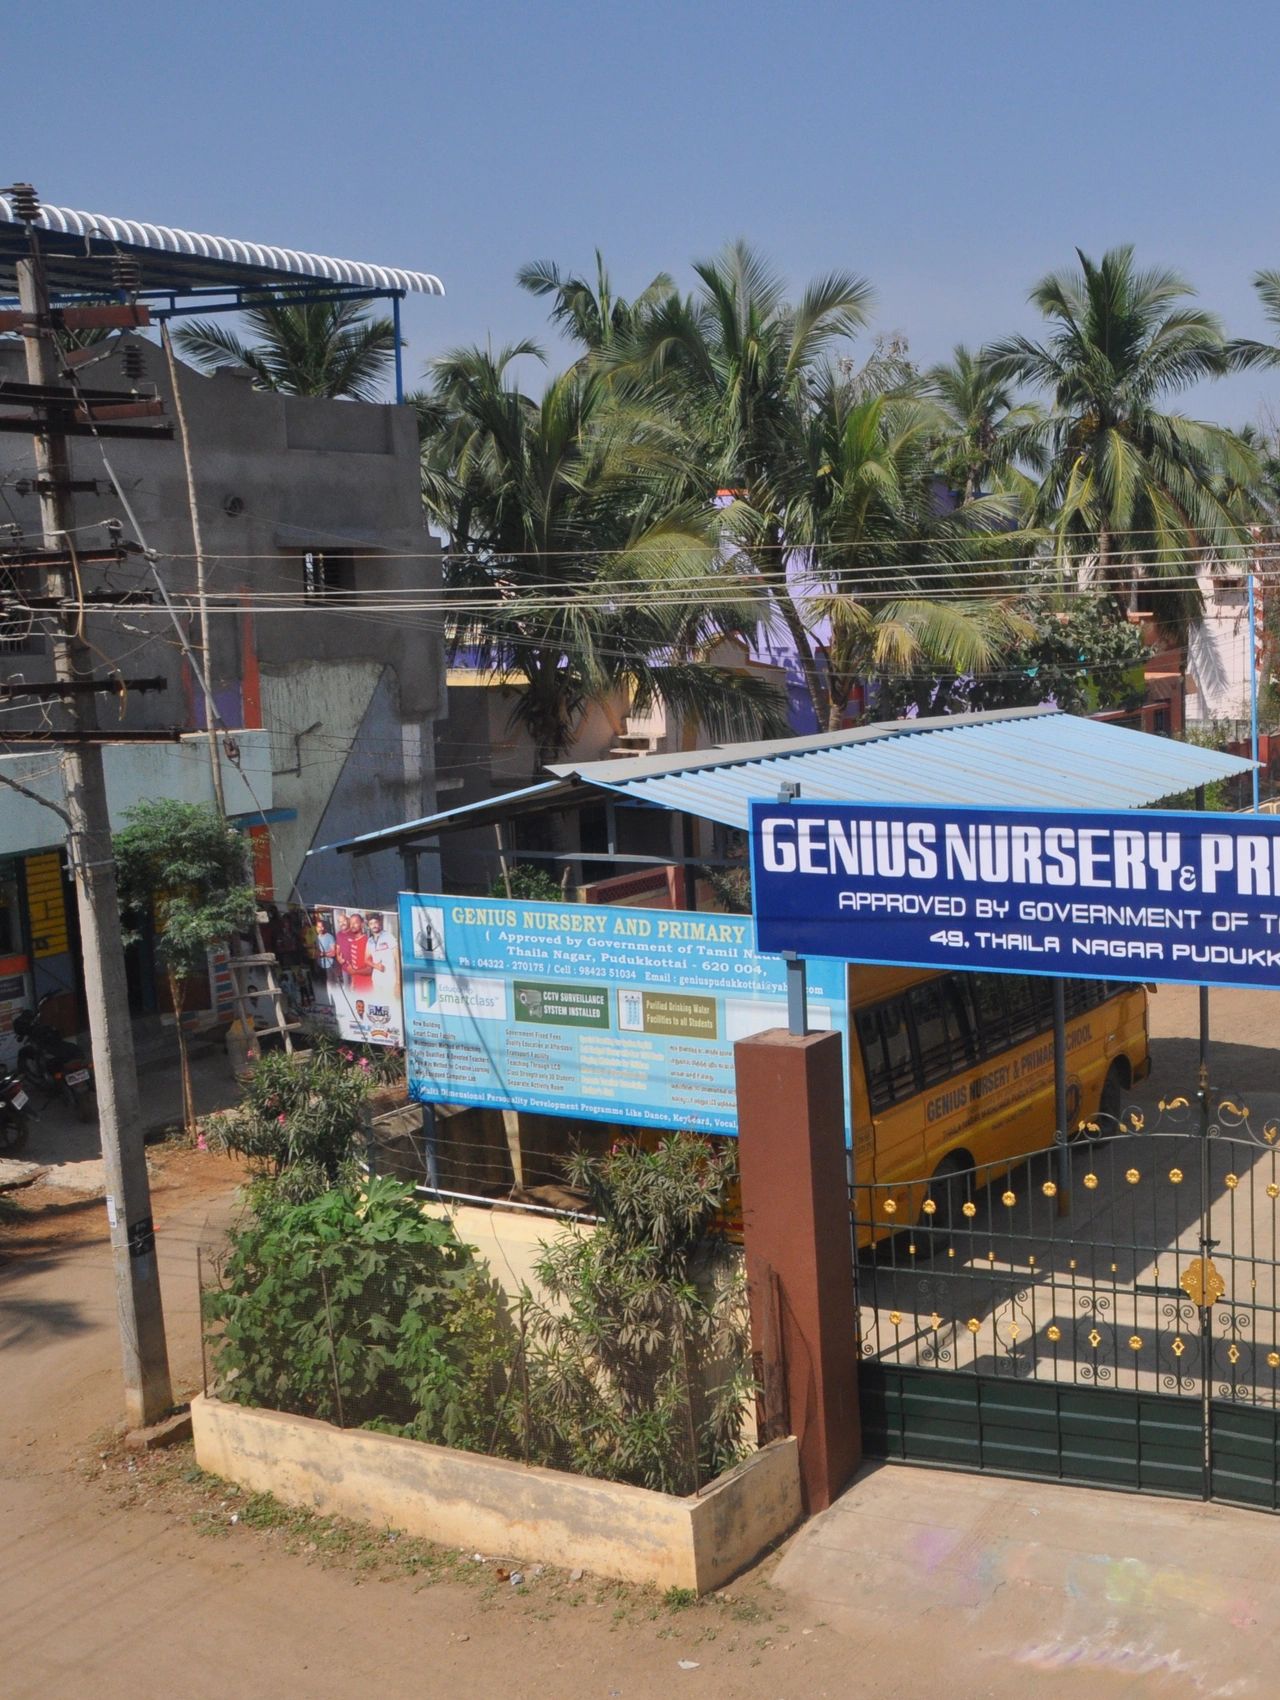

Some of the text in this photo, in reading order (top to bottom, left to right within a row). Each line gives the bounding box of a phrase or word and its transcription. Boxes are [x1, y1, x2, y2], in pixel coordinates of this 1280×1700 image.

[761, 817, 937, 879] GENIUS
[945, 823, 1180, 892] NURSERY
[1179, 865, 1197, 892] &
[839, 891, 966, 917] APPROVED
[976, 898, 1010, 919] BY
[1019, 900, 1201, 932] GOVERNMENT
[1212, 911, 1249, 931] OF
[452, 906, 745, 944] GENIUS NURSERY AND PRIMARY
[498, 931, 562, 945] Approved
[566, 935, 583, 948] by
[587, 937, 673, 953] Government
[678, 944, 693, 955] of
[696, 945, 738, 958] Tamil
[976, 931, 1061, 954] THAILA
[1072, 937, 1164, 960] NAGAR
[477, 958, 504, 969] 04322
[512, 961, 544, 972] 270175
[554, 964, 571, 974] Cell
[644, 971, 671, 982] Email
[506, 946, 548, 959] Thaila
[553, 950, 596, 963] Nagar,
[600, 952, 688, 969] Pudukkottai
[702, 961, 729, 972] 620
[543, 991, 605, 1005] CCTV SURVEILLANCE
[668, 1002, 692, 1014] Drinking
[692, 1004, 710, 1014] Water
[544, 1005, 600, 1018] SYSTEM INSTALLED
[646, 1014, 672, 1024] Facilities
[672, 1017, 679, 1025] to
[689, 1017, 713, 1028] Students
[927, 1084, 968, 1123] GENIUS
[969, 1064, 1010, 1102] NURSERY
[1021, 1041, 1055, 1076] PRIMAR
[1065, 1023, 1092, 1052] CHOOL
[530, 1097, 580, 1111] Development
[581, 1103, 624, 1116] Programme
[625, 1108, 642, 1117] Like
